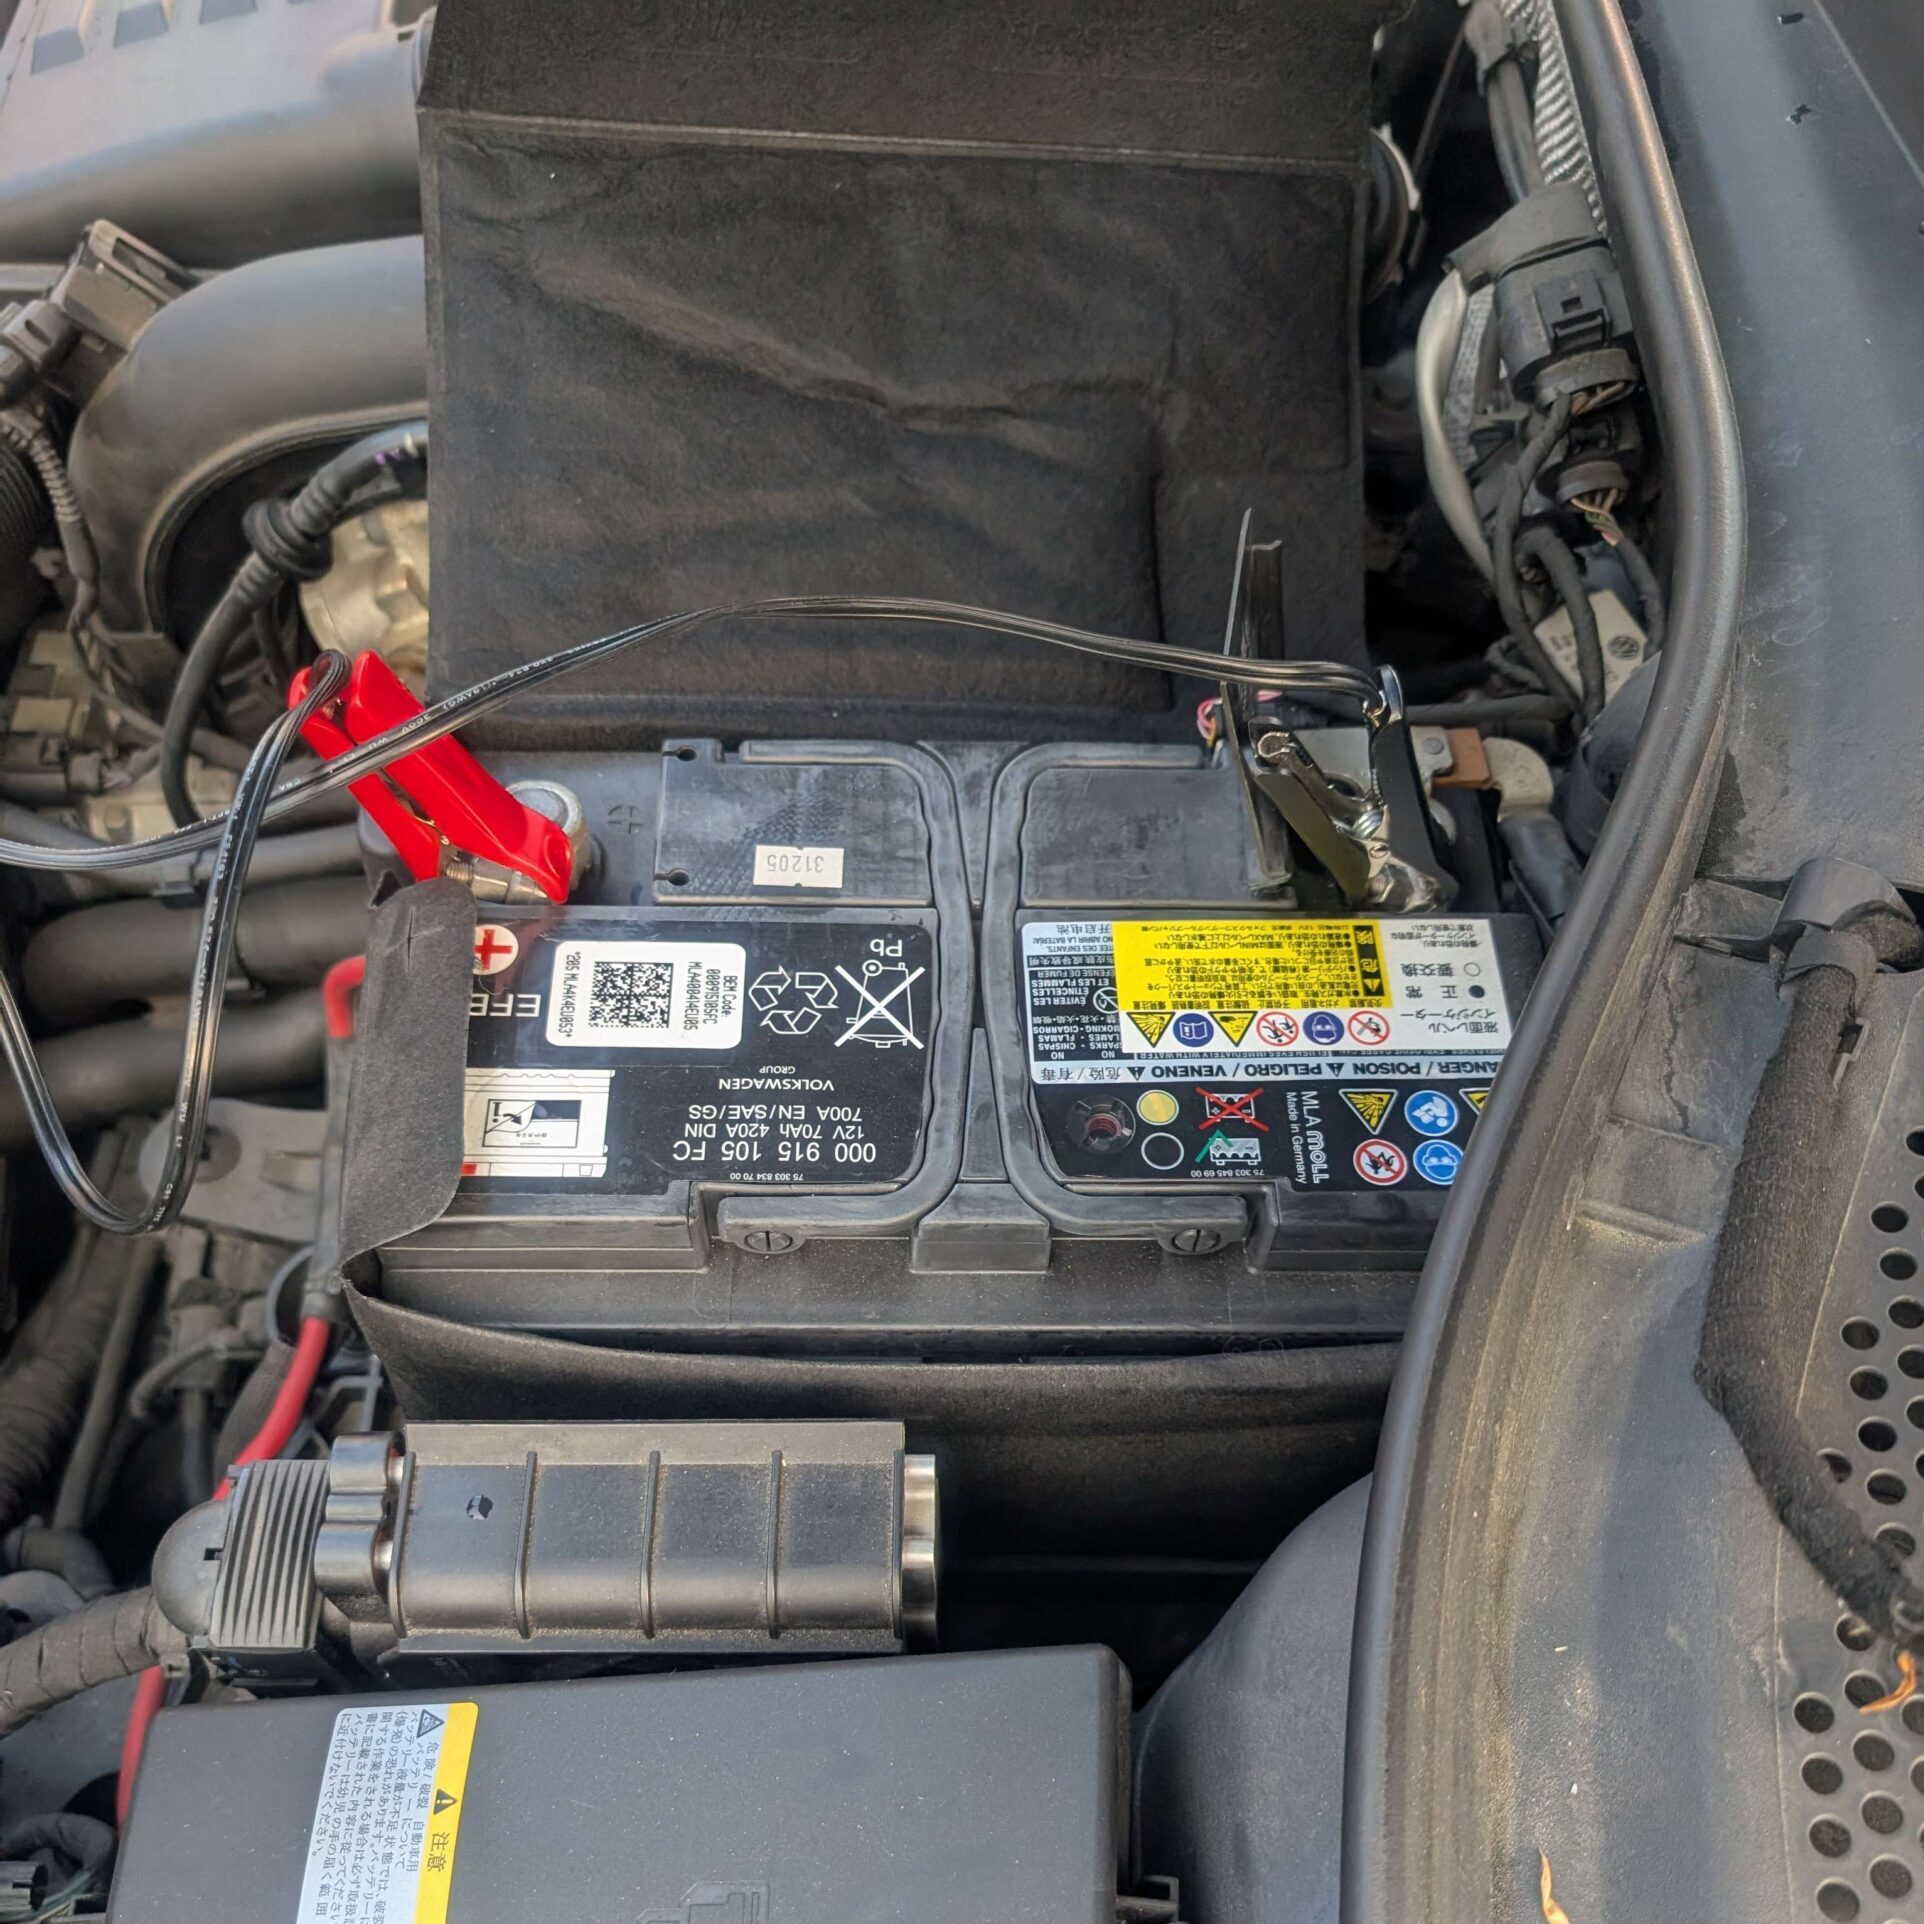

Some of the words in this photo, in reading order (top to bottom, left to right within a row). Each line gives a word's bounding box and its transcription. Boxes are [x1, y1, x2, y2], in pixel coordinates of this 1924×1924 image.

[401, 714, 431, 735] 300V
[279, 778, 301, 791] CSA
[766, 854, 825, 873] 31205
[869, 939, 903, 957] Pb
[1082, 945, 1097, 953] DES
[1356, 930, 1378, 973] 危険
[1400, 963, 1455, 977] 要交換
[724, 975, 738, 992] BEM
[1031, 979, 1076, 987] FLAMMES
[1077, 978, 1096, 986] LES
[1097, 978, 1109, 986] ET
[684, 961, 703, 1031] MLA400414EU05
[703, 968, 720, 1025] 000915105FC
[1032, 987, 1089, 996] ÉTINCELLES
[722, 993, 735, 1018] Code:
[1033, 998, 1051, 1006] LES
[1052, 996, 1086, 1006] ÉVITER
[1400, 1009, 1496, 1020] インジケーター
[1428, 1022, 1498, 1034] 液面レベル
[1038, 1042, 1076, 1050] CHISPAS
[1051, 1051, 1064, 1059] NO
[759, 1065, 796, 1074] GROUP
[1151, 1065, 1228, 1078] VENENO
[1244, 1064, 1321, 1077] PELIGRO
[1353, 1062, 1421, 1075] POISON
[1437, 1061, 1498, 1074] ANGER
[719, 1079, 834, 1091] VOLKSWAGEN
[688, 1105, 805, 1120] EN/SAE/GS
[1286, 1091, 1300, 1121] Made
[1300, 1090, 1322, 1127] MLA
[816, 1106, 863, 1121] 700A
[684, 1123, 716, 1137] DIN
[726, 1123, 770, 1138] 420A
[780, 1124, 822, 1138] 70Ah
[832, 1125, 865, 1139] 12V
[1290, 1123, 1302, 1132] in
[672, 1141, 706, 1160] FC
[721, 1141, 762, 1161] 105
[778, 1141, 820, 1161] 915
[835, 1142, 876, 1162] 000
[1291, 1135, 1307, 1184] Germany
[730, 1172, 741, 1180] 00
[775, 1173, 791, 1181] 303
[793, 1173, 804, 1181] 75
[1190, 1170, 1202, 1178] 00
[311, 1713, 352, 1857] に近付けないでください。
[406, 1820, 425, 1873] 自動車用
[427, 1831, 450, 1873] 注意
